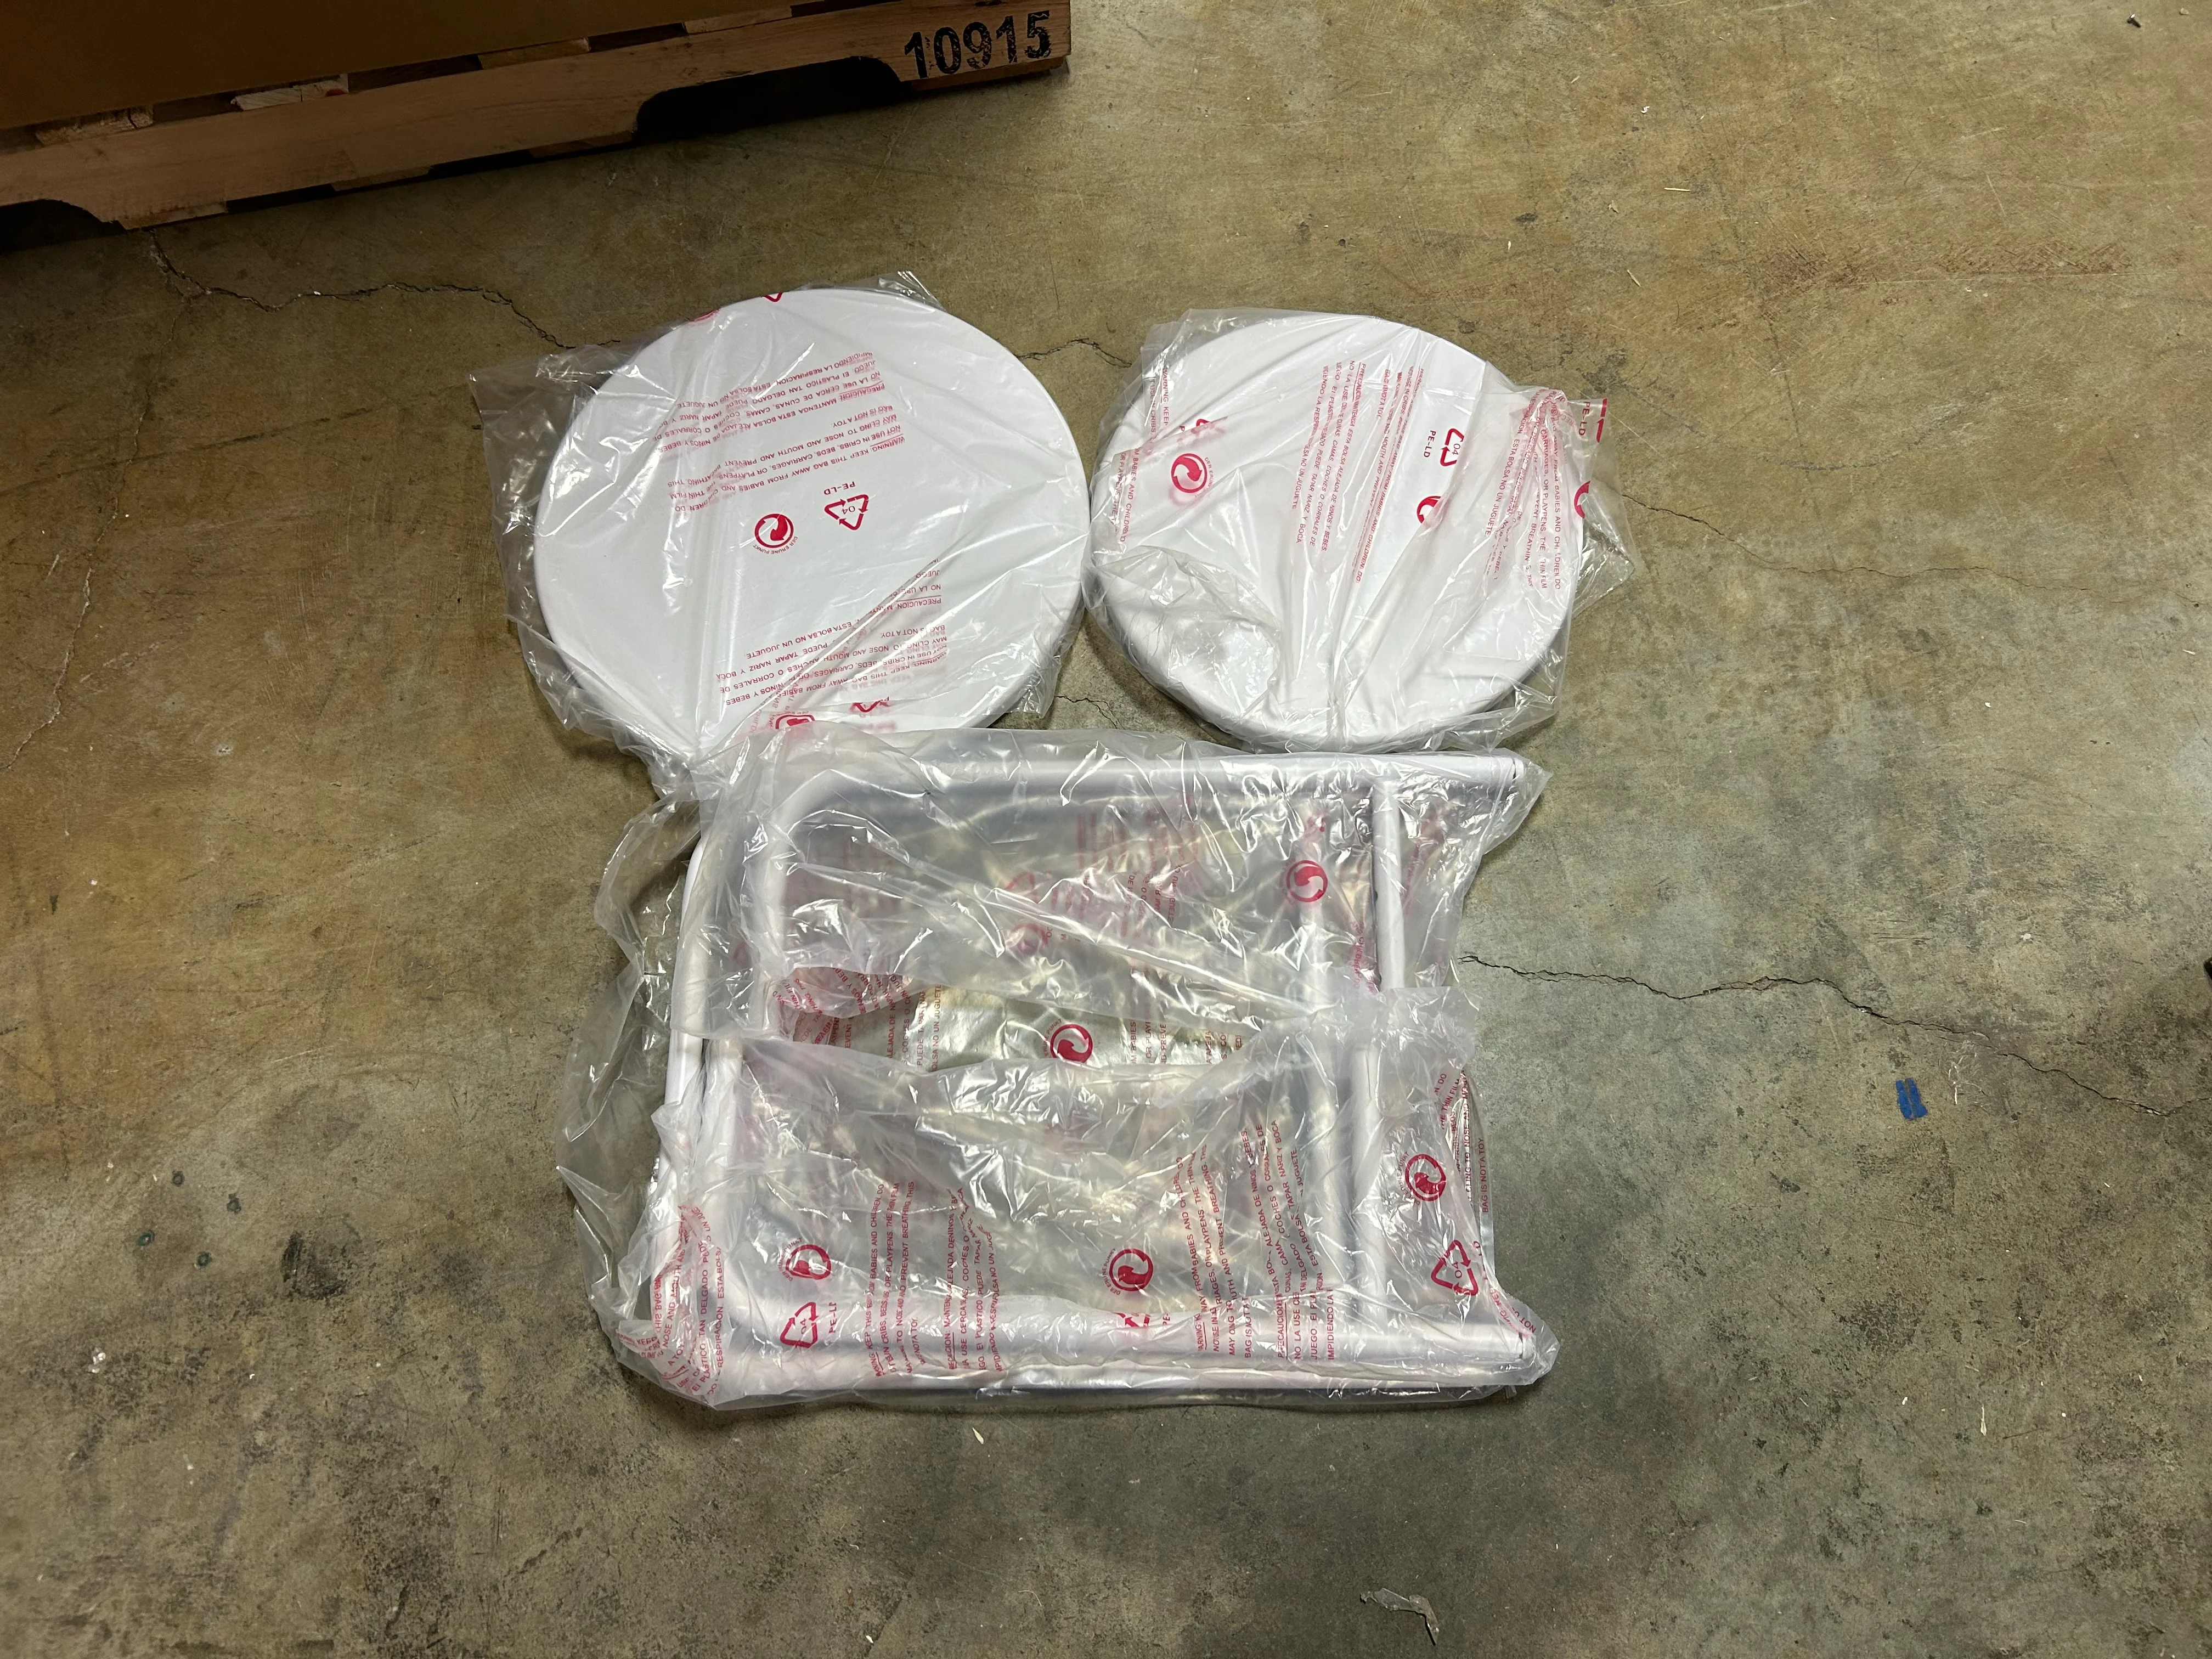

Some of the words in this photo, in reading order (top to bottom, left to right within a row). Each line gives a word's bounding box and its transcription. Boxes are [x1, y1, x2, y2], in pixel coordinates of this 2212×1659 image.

[904, 10, 1052, 78] 10915
[1349, 360, 1355, 371] NO
[806, 375, 840, 388] PLASTICO
[816, 385, 839, 396] CERCA
[752, 391, 786, 404] DELGADO
[1316, 396, 1323, 405] LA
[799, 398, 837, 413] MANTENGA
[753, 416, 777, 427] BOLSA
[777, 411, 795, 420] ESTA
[855, 412, 868, 421] NOT
[1578, 402, 1591, 436] PE-LD
[859, 420, 880, 431] CLING
[665, 427, 702, 437] CORRALES
[825, 432, 844, 442] NOSE
[871, 431, 885, 440] USE
[806, 439, 821, 448] AND
[1423, 430, 1436, 458] PE-LD
[1452, 443, 1461, 455] 04
[1510, 439, 1520, 457] ESTA
[777, 444, 804, 456] MOUTH
[851, 449, 869, 459] KEEP
[1340, 445, 1348, 465] BOLSA
[760, 453, 775, 461] AND
[1314, 450, 1323, 469] PUEDE
[725, 459, 757, 474] PREVENT
[792, 466, 810, 476] AWAY
[813, 461, 828, 470] BAG
[1503, 456, 1514, 478] BOLSA
[667, 479, 684, 488] THIS
[768, 473, 788, 484] FROM
[1322, 465, 1331, 492] COCHES
[1334, 466, 1344, 492] ALEJADA
[1383, 471, 1392, 490] FROM
[738, 481, 764, 492] BABIES
[823, 482, 855, 495] PE-LD
[1499, 480, 1507, 490] NO
[670, 491, 689, 499] FILM
[688, 490, 705, 499] THIN
[1331, 494, 1337, 503] DE
[1496, 492, 1503, 502] UN
[1304, 494, 1312, 513] NARIZ
[842, 506, 855, 515] 04
[1313, 501, 1323, 534] CORRALES
[1296, 523, 1306, 543] BOCA
[789, 536, 798, 546] DER
[1310, 537, 1316, 546] DE
[833, 622, 853, 631] ESTA
[808, 628, 832, 639] BOLSA
[803, 643, 828, 654] PUEDE
[775, 652, 797, 663] TAPAR
[824, 651, 849, 661] MOUTH
[749, 661, 771, 672] NARIZ
[716, 671, 737, 680] BOCA
[733, 673, 775, 690] CORRALES
[889, 1014, 896, 1025] DE
[933, 1022, 940, 1032] UN
[1255, 1124, 1264, 1137] DE
[1271, 1121, 1282, 1144] BOCA
[1463, 1125, 1471, 1147] NOSE
[1464, 1152, 1471, 1163] TO
[1479, 1156, 1485, 1164] A
[1481, 1184, 1487, 1192] IS
[1192, 1187, 1201, 1204] THE
[1254, 1195, 1262, 1207] DE
[1283, 1182, 1294, 1209] TAPAR
[1182, 1211, 1190, 1229] AND
[1269, 1195, 1285, 1234] COCHES
[870, 1249, 878, 1279] BABIES
[877, 1184, 884, 1194] DO
[1259, 1209, 1272, 1246] ALEJADA
[1293, 1215, 1308, 1244] BOLSA
[1187, 1234, 1199, 1266] BABIES
[1305, 1244, 1319, 1267] ESTA
[896, 1330, 903, 1343] TO
[900, 1243, 909, 1281] PREVENT
[906, 1181, 915, 1198] THIS
[988, 1252, 995, 1265] UN
[989, 1267, 997, 1277] NO
[1221, 1259, 1231, 1276] AND
[1452, 1261, 1463, 1279] 04
[1192, 1266, 1203, 1291] FROM
[700, 1270, 708, 1314] DELGADO
[1327, 1294, 1334, 1305] LA
[662, 1324, 672, 1347] NOSE
[667, 1302, 675, 1321] AND
[1294, 1330, 1301, 1341] LA
[1294, 1346, 1301, 1359] NO
